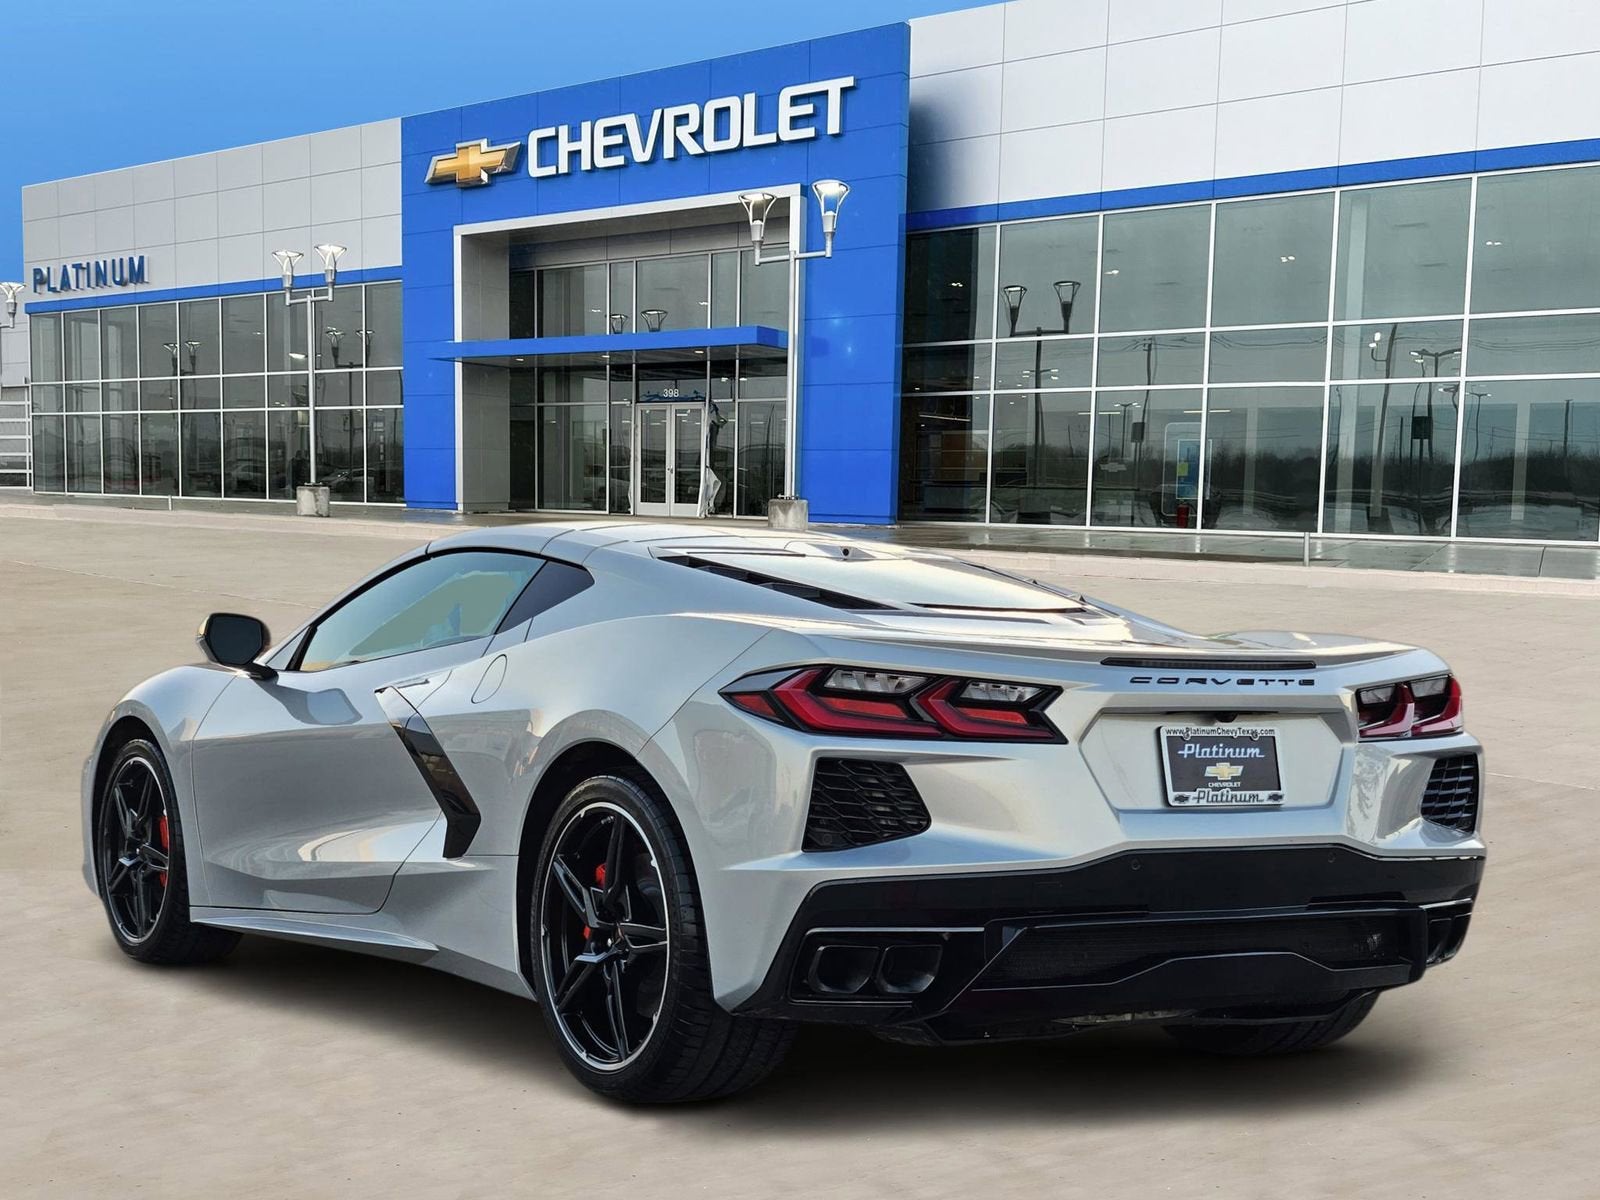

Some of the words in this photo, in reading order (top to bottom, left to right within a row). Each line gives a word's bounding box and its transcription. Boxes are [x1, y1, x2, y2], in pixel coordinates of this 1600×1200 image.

[527, 75, 856, 179] CHEVROLET
[33, 255, 148, 294] PLATINUM
[663, 388, 679, 398] 398
[1130, 677, 1314, 686] CORVETTE
[1178, 743, 1265, 759] Platinum
[1192, 789, 1264, 803] Platinum
